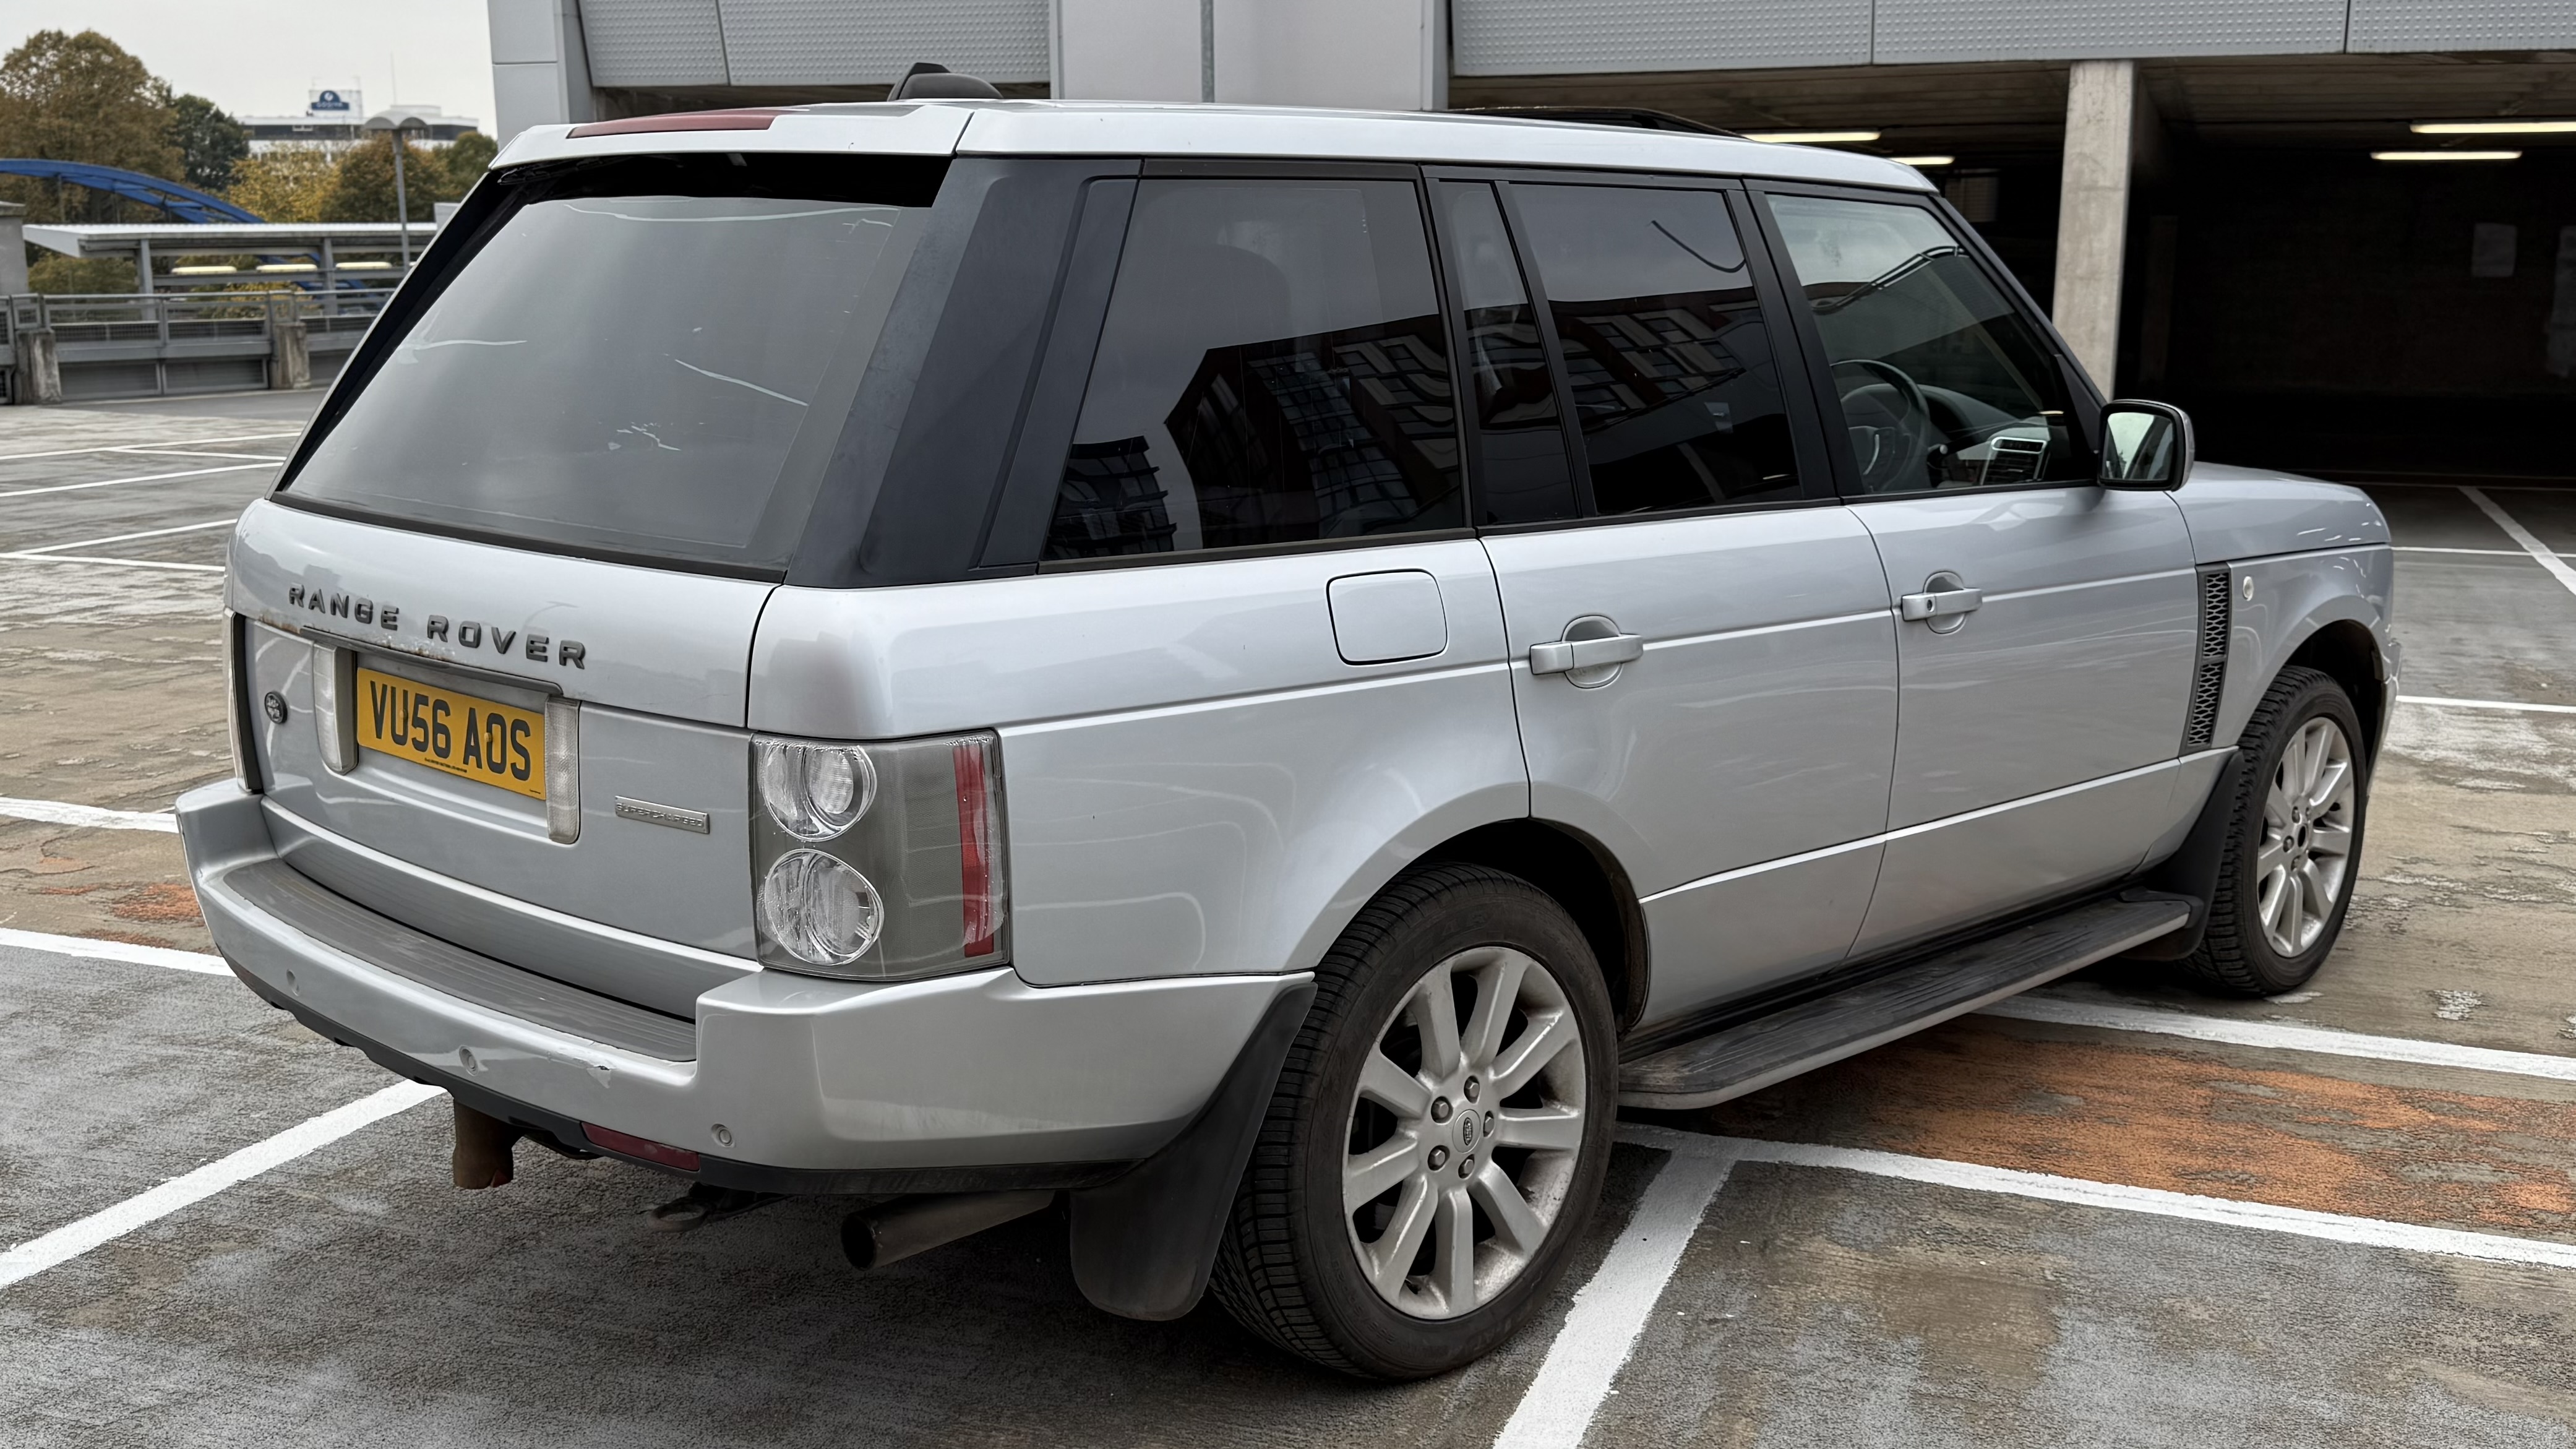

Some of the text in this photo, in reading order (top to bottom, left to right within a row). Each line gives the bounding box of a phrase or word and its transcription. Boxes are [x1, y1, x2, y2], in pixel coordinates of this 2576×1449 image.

[289, 582, 586, 670] RANGE ROVER
[370, 681, 531, 781] VU56 AOS
